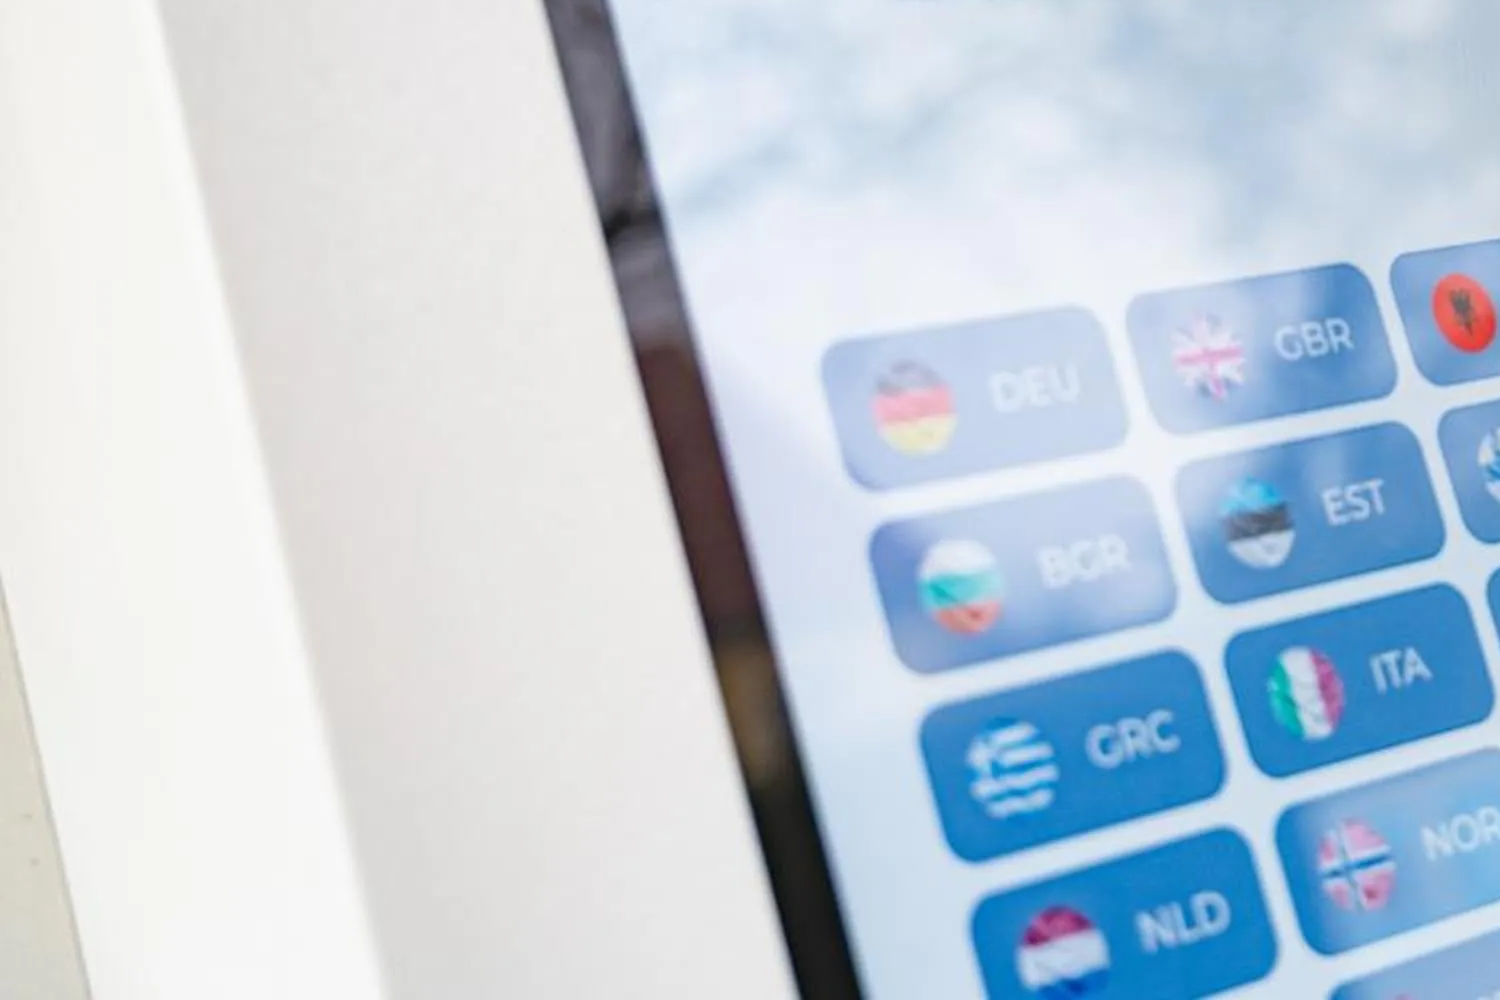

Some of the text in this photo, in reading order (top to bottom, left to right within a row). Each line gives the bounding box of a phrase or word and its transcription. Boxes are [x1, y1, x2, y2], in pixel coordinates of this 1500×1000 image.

[1273, 319, 1355, 364] GBR
[987, 362, 1080, 413] DEU
[1321, 479, 1386, 526] EST
[1034, 534, 1131, 590] BGR
[1370, 644, 1432, 693] ITA
[1084, 711, 1181, 770] GRC
[1133, 892, 1232, 953] NLD
